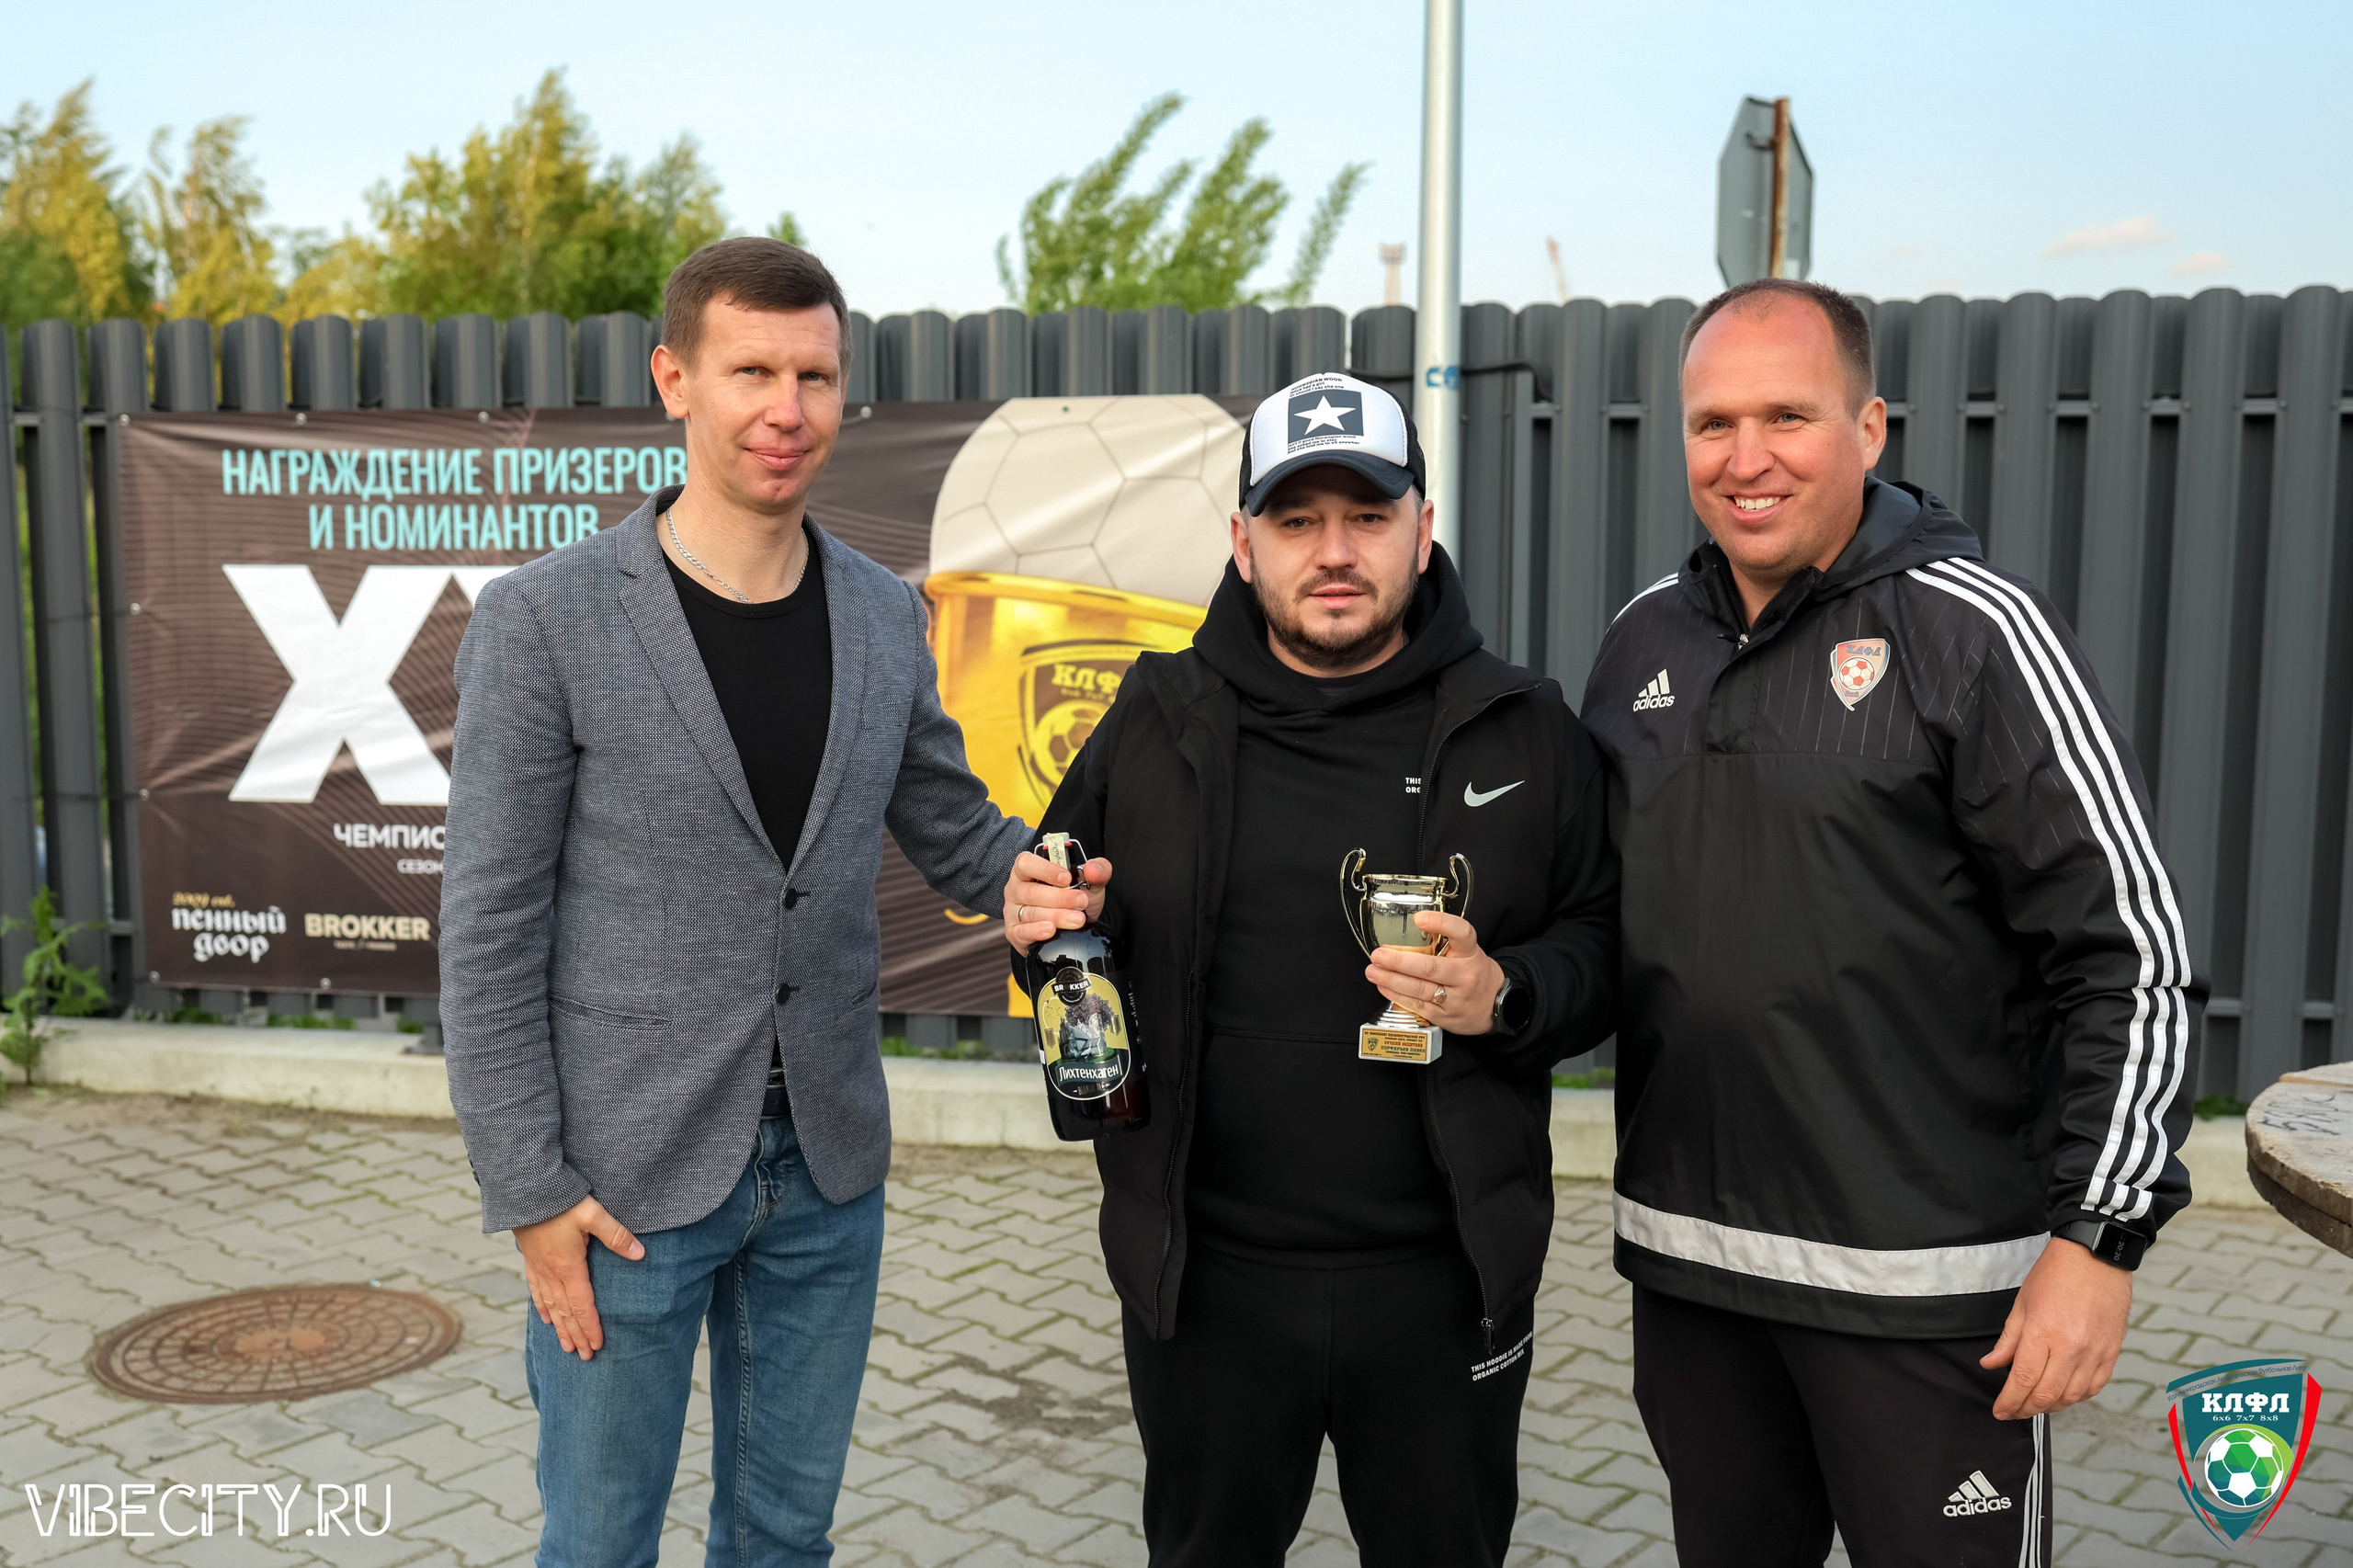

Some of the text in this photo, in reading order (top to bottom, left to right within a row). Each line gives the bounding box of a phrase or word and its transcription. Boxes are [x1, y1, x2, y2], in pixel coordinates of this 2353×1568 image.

[222, 446, 688, 502] НАГРАЖДЕНИЕ ПРИЗЕРОВ
[309, 503, 599, 550] И НОМИНАНТОВ
[1632, 693, 1675, 712] adidas
[304, 913, 431, 941] BROKKER
[1053, 980, 1090, 993] BRKKER
[1059, 1063, 1120, 1083] Лихтенхаген
[1471, 1362, 1485, 1372] THIS
[1486, 1352, 1507, 1368] HOODIE
[1507, 1348, 1513, 1358] IS
[1472, 1365, 1500, 1381] ORGANIC
[1500, 1355, 1518, 1369] COTTON
[1942, 1496, 2013, 1517] adidas
